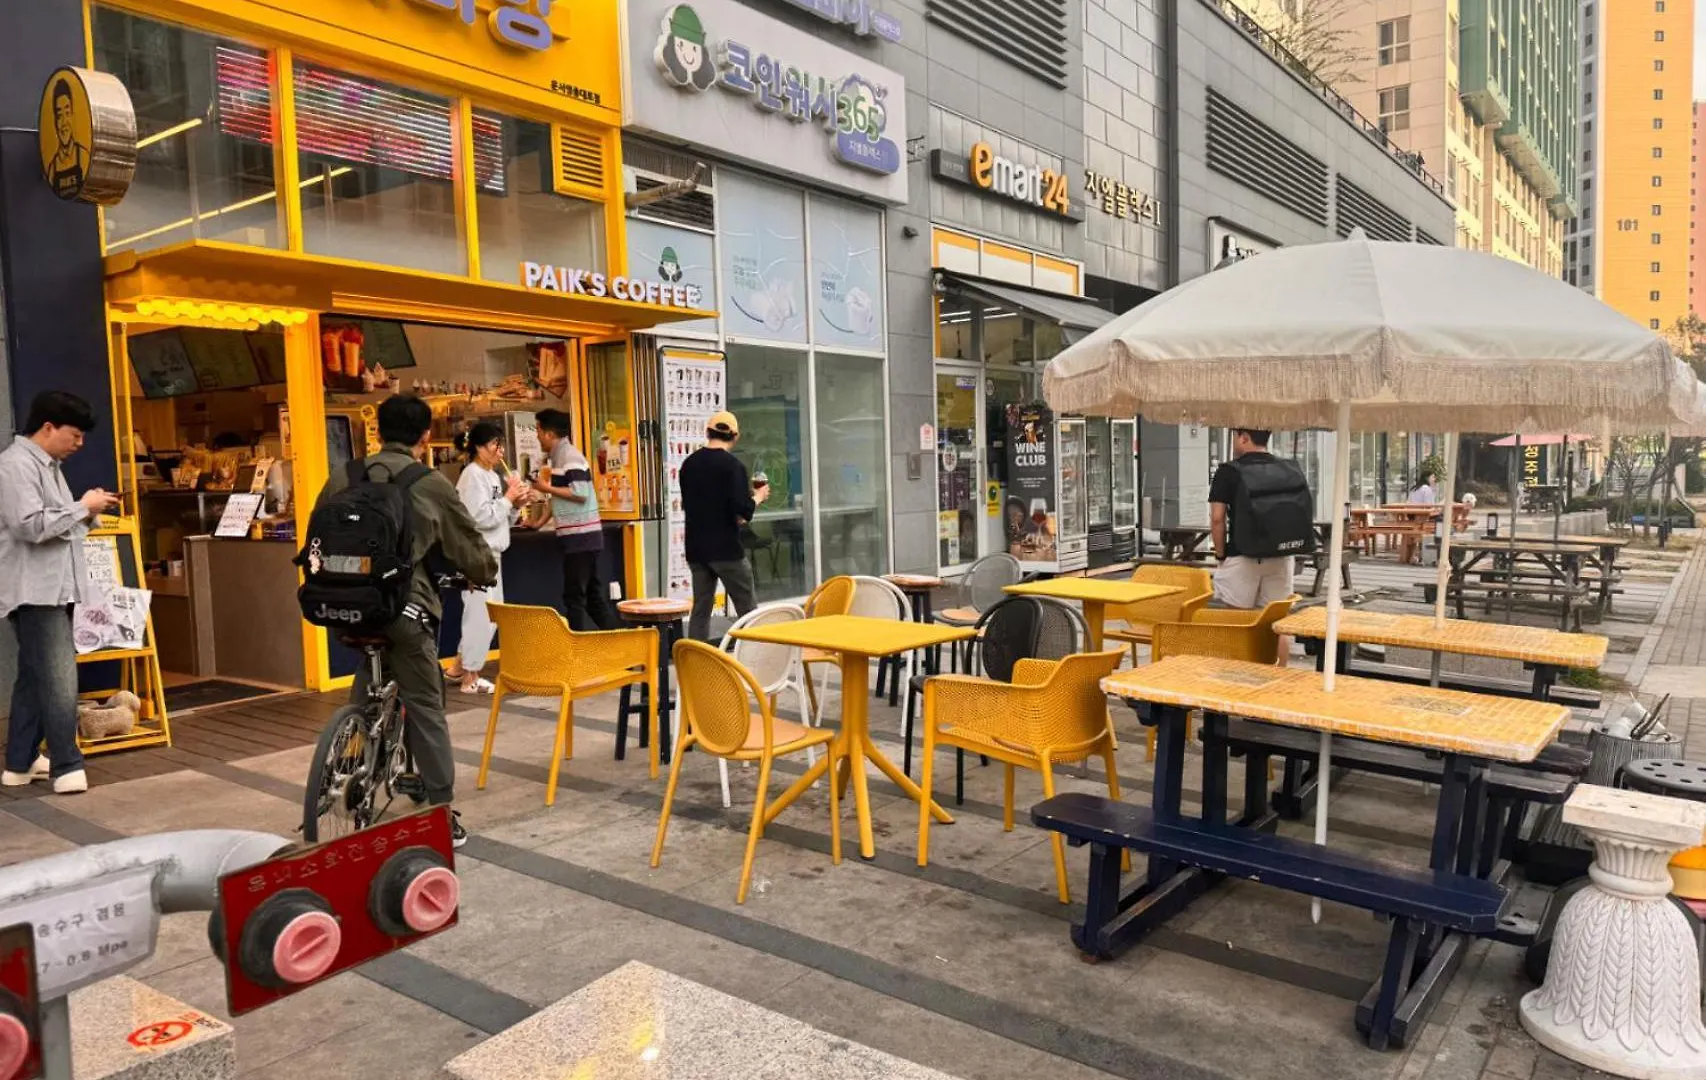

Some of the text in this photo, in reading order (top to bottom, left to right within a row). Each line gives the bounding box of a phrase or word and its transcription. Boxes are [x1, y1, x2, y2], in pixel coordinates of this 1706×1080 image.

[722, 39, 881, 143] 코인워시 365
[969, 140, 1070, 216] emart24
[1616, 219, 1639, 231] 101
[521, 261, 702, 308] PAIK'S COFFEE
[1014, 441, 1046, 453] WINE
[1015, 454, 1046, 466] CLUB
[315, 603, 362, 624] Jeep
